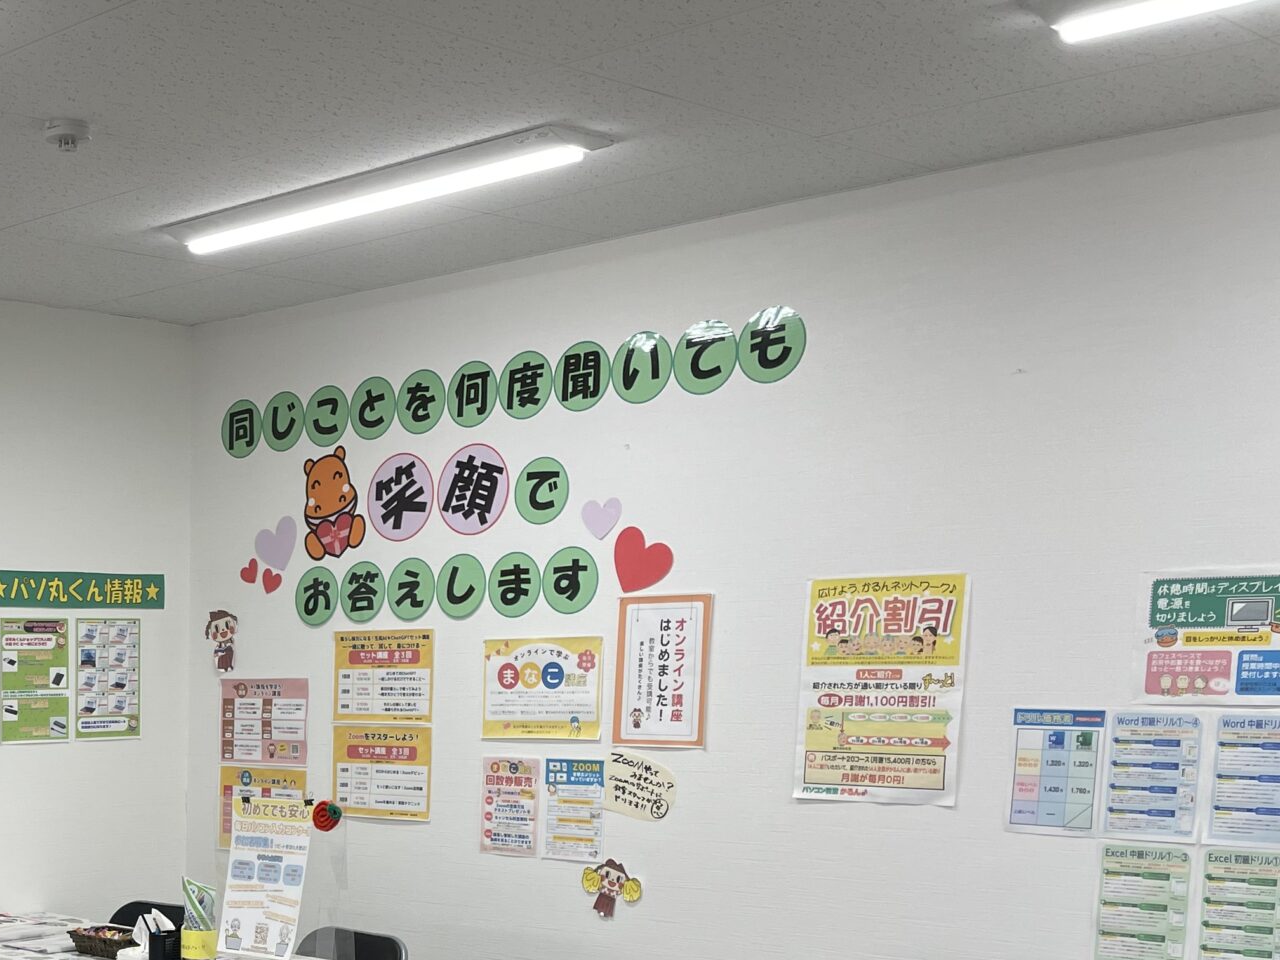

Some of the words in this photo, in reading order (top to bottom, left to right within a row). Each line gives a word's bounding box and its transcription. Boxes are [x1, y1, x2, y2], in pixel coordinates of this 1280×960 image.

[227, 321, 794, 452] 同じことを何度聞いても
[375, 453, 559, 530] 笑顔で
[9, 575, 143, 604] パソ丸くん情報
[302, 559, 589, 613] お答えします
[1157, 597, 1191, 610] 電源を
[816, 596, 954, 635] 紹介割引
[1156, 611, 1216, 623] 切りましょう
[360, 651, 388, 659] セット講座
[514, 648, 570, 661] オンラインで学ぶ
[501, 666, 561, 686] まなこ
[656, 618, 671, 722] はじめました！
[670, 618, 687, 722] オンライン講座
[1240, 671, 1280, 679] 受付します
[1117, 717, 1139, 726] Word
[1222, 719, 1246, 729] Word
[348, 733, 419, 741] Zoomをマスターしよう！
[358, 747, 386, 755] セット講座
[572, 762, 600, 772] ZOOM
[1105, 848, 1128, 858] Excel
[1208, 853, 1232, 863] Excel
